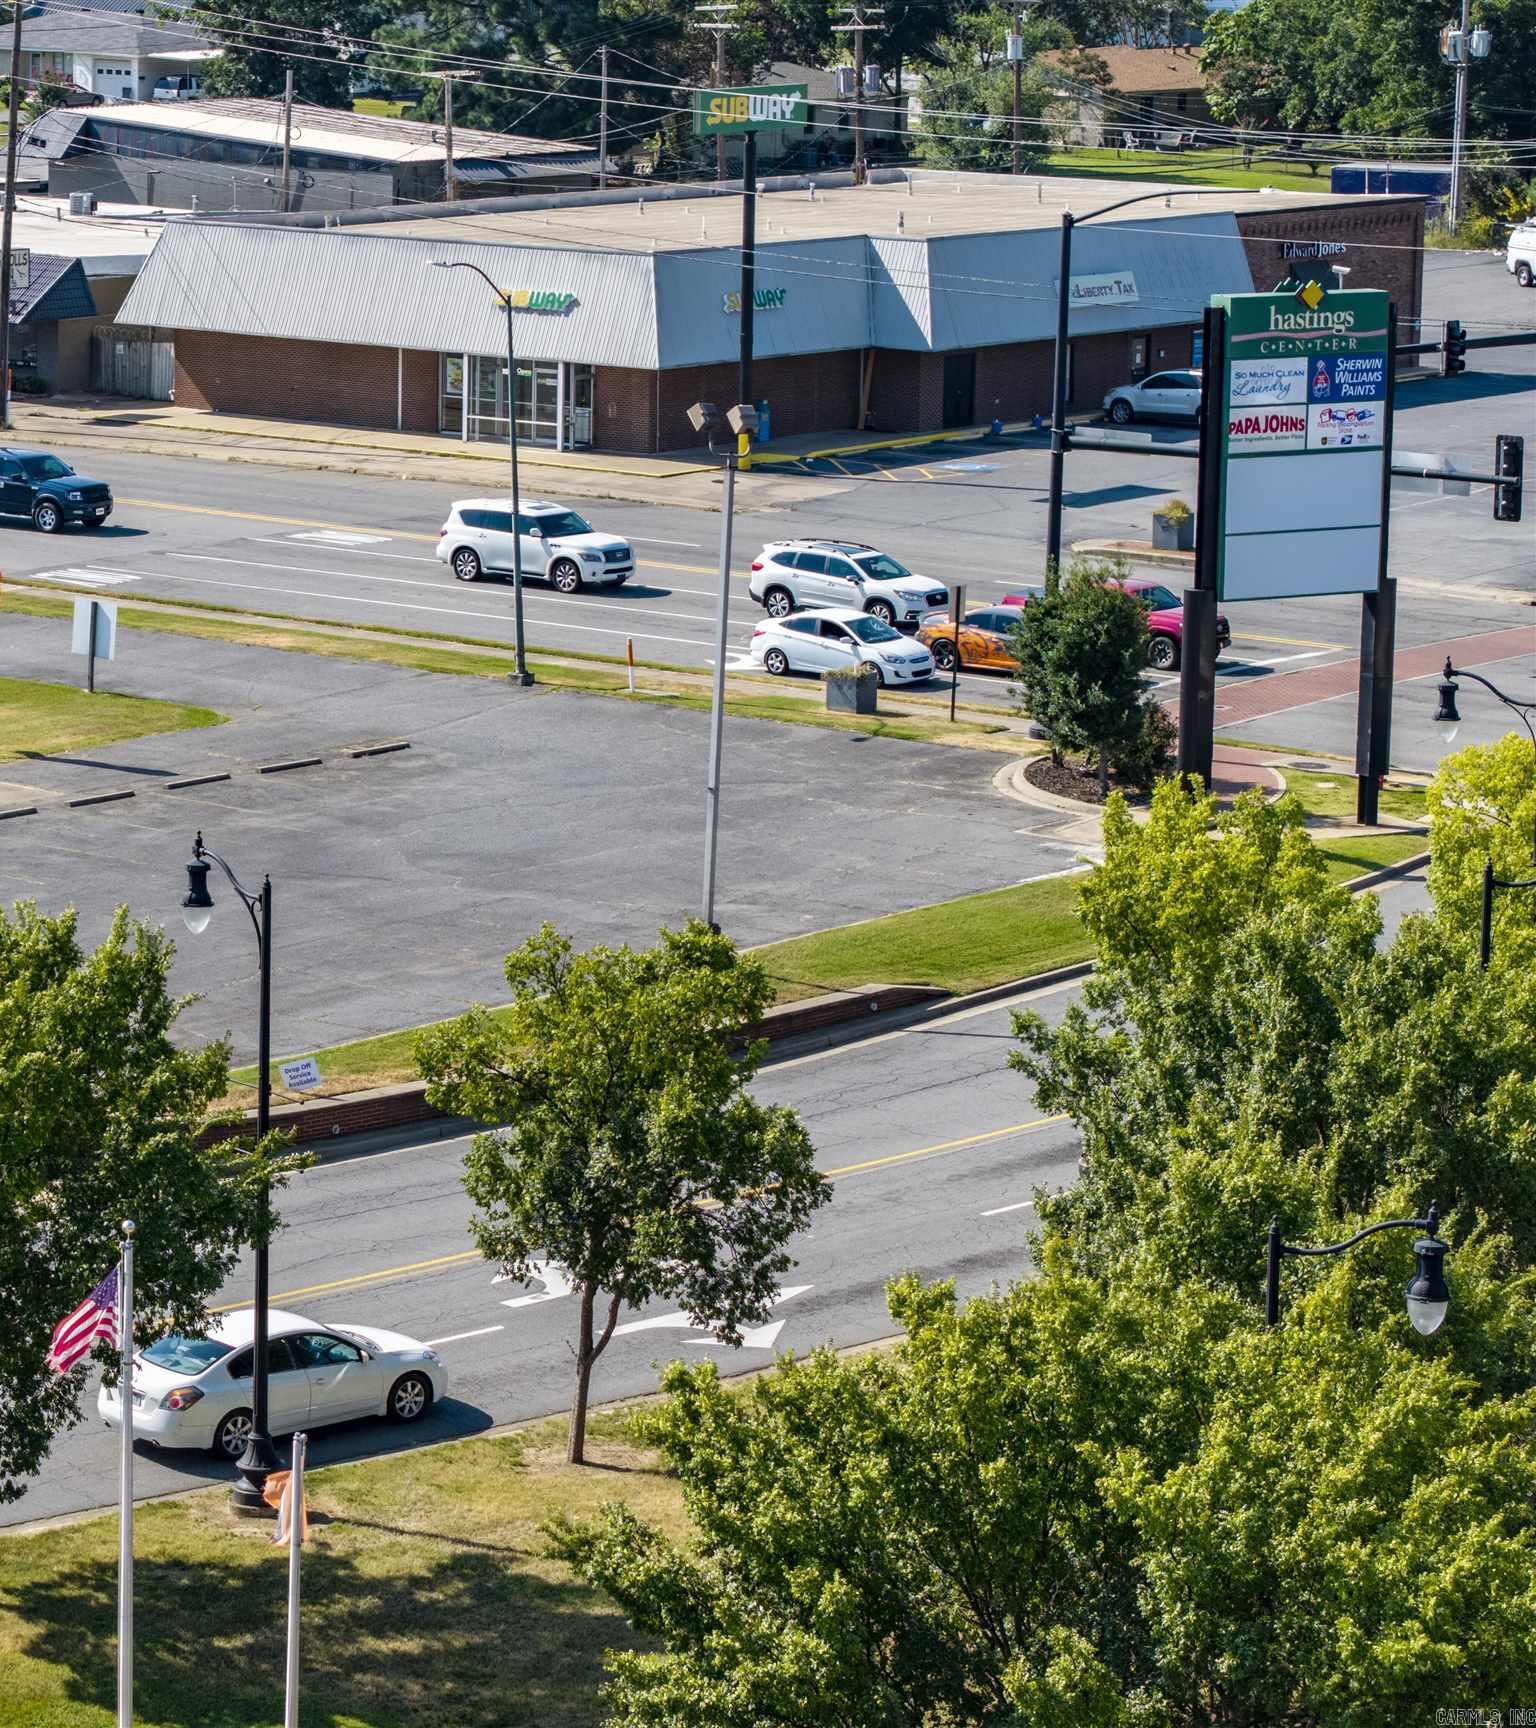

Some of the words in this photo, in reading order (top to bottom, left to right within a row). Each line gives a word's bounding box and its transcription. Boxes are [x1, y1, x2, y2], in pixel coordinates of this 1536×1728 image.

[706, 91, 801, 127] SUBWAY
[1283, 242, 1317, 258] Edward
[1317, 240, 1347, 257] Jones
[1075, 283, 1114, 299] LIBERTY
[1114, 280, 1135, 296] TAX
[1268, 304, 1355, 335] hastings
[1336, 357, 1383, 371] SHERWIN
[1248, 371, 1274, 379] MUCH
[1275, 369, 1305, 378] CLEAN
[1335, 370, 1383, 384] WILLIAMS
[1232, 379, 1292, 400] Laundry
[1341, 383, 1376, 397] PAINTS
[1229, 415, 1261, 435] PAPA
